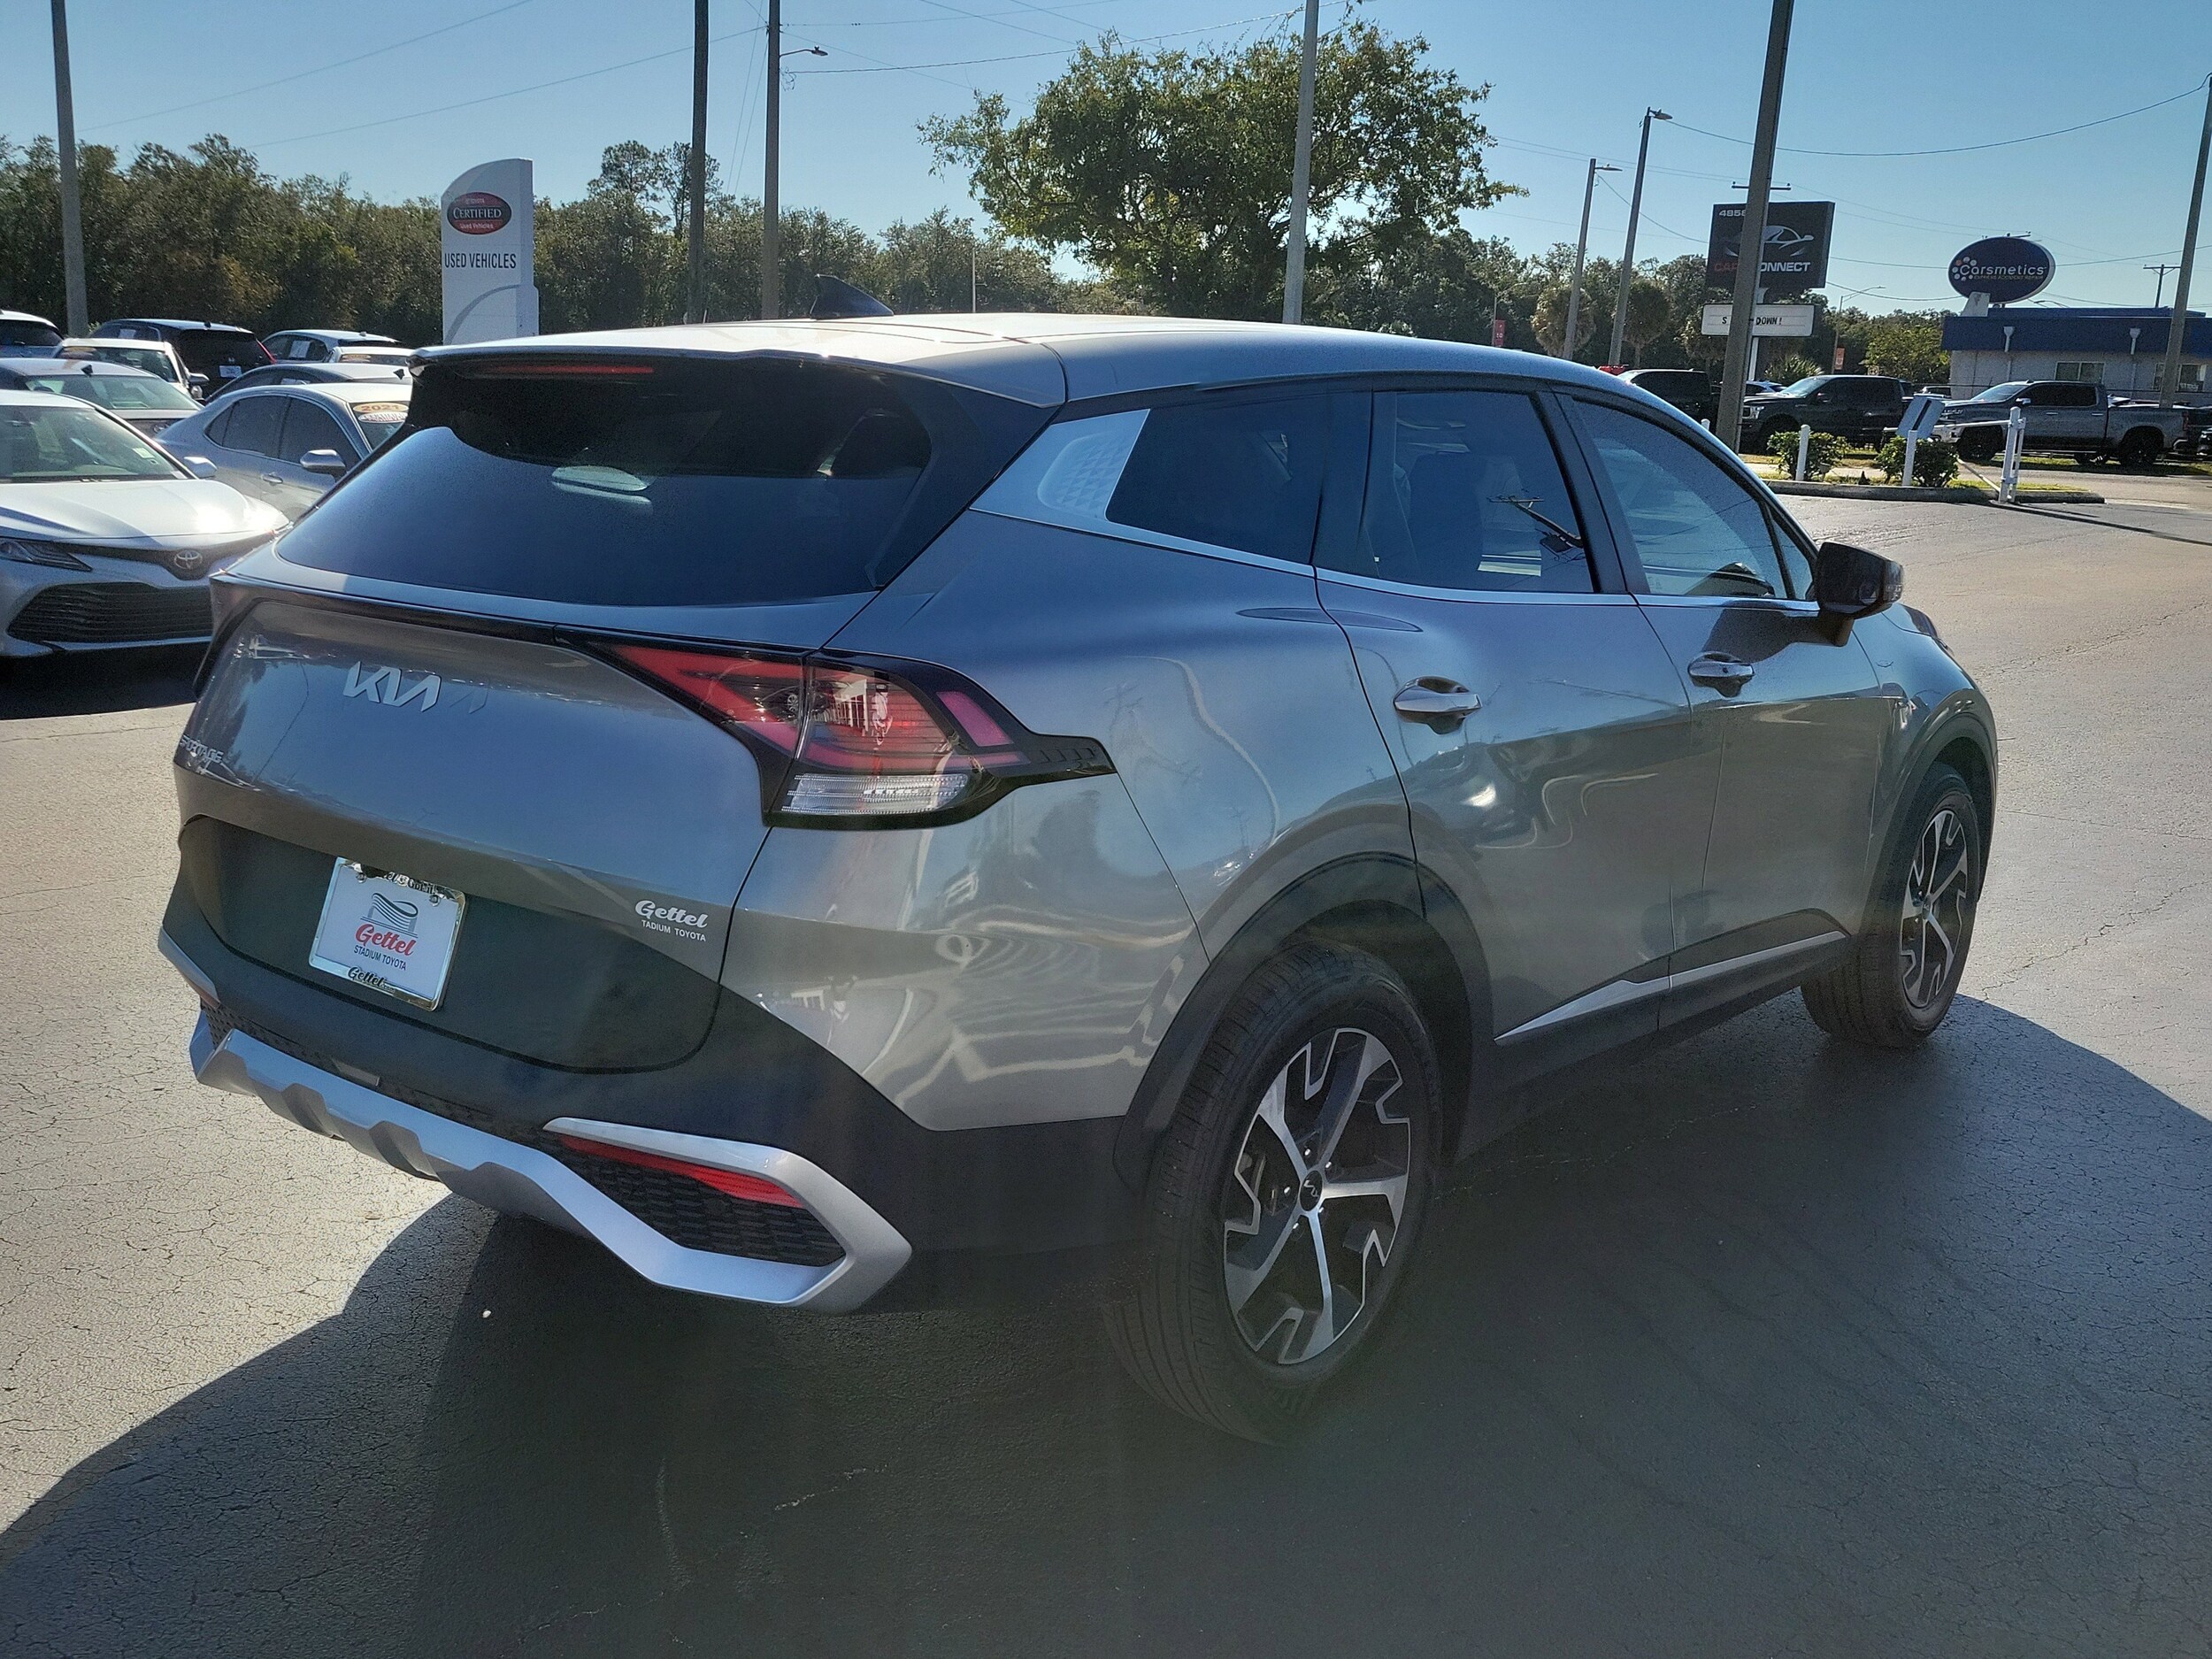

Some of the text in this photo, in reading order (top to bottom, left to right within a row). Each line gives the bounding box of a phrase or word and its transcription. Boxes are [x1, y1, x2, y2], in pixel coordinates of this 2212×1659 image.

[453, 207, 502, 219] CERTIFIED
[444, 252, 517, 269] USED VEHICLES
[1760, 262, 1811, 272] ONNECT
[1960, 265, 2044, 275] Carsmetics
[342, 661, 442, 712] KIA
[634, 900, 708, 928] Gettel
[356, 924, 418, 956] Gettel
[641, 919, 706, 942] TADIUM TOYOTA
[354, 944, 406, 971] STADIUM TOYOTA
